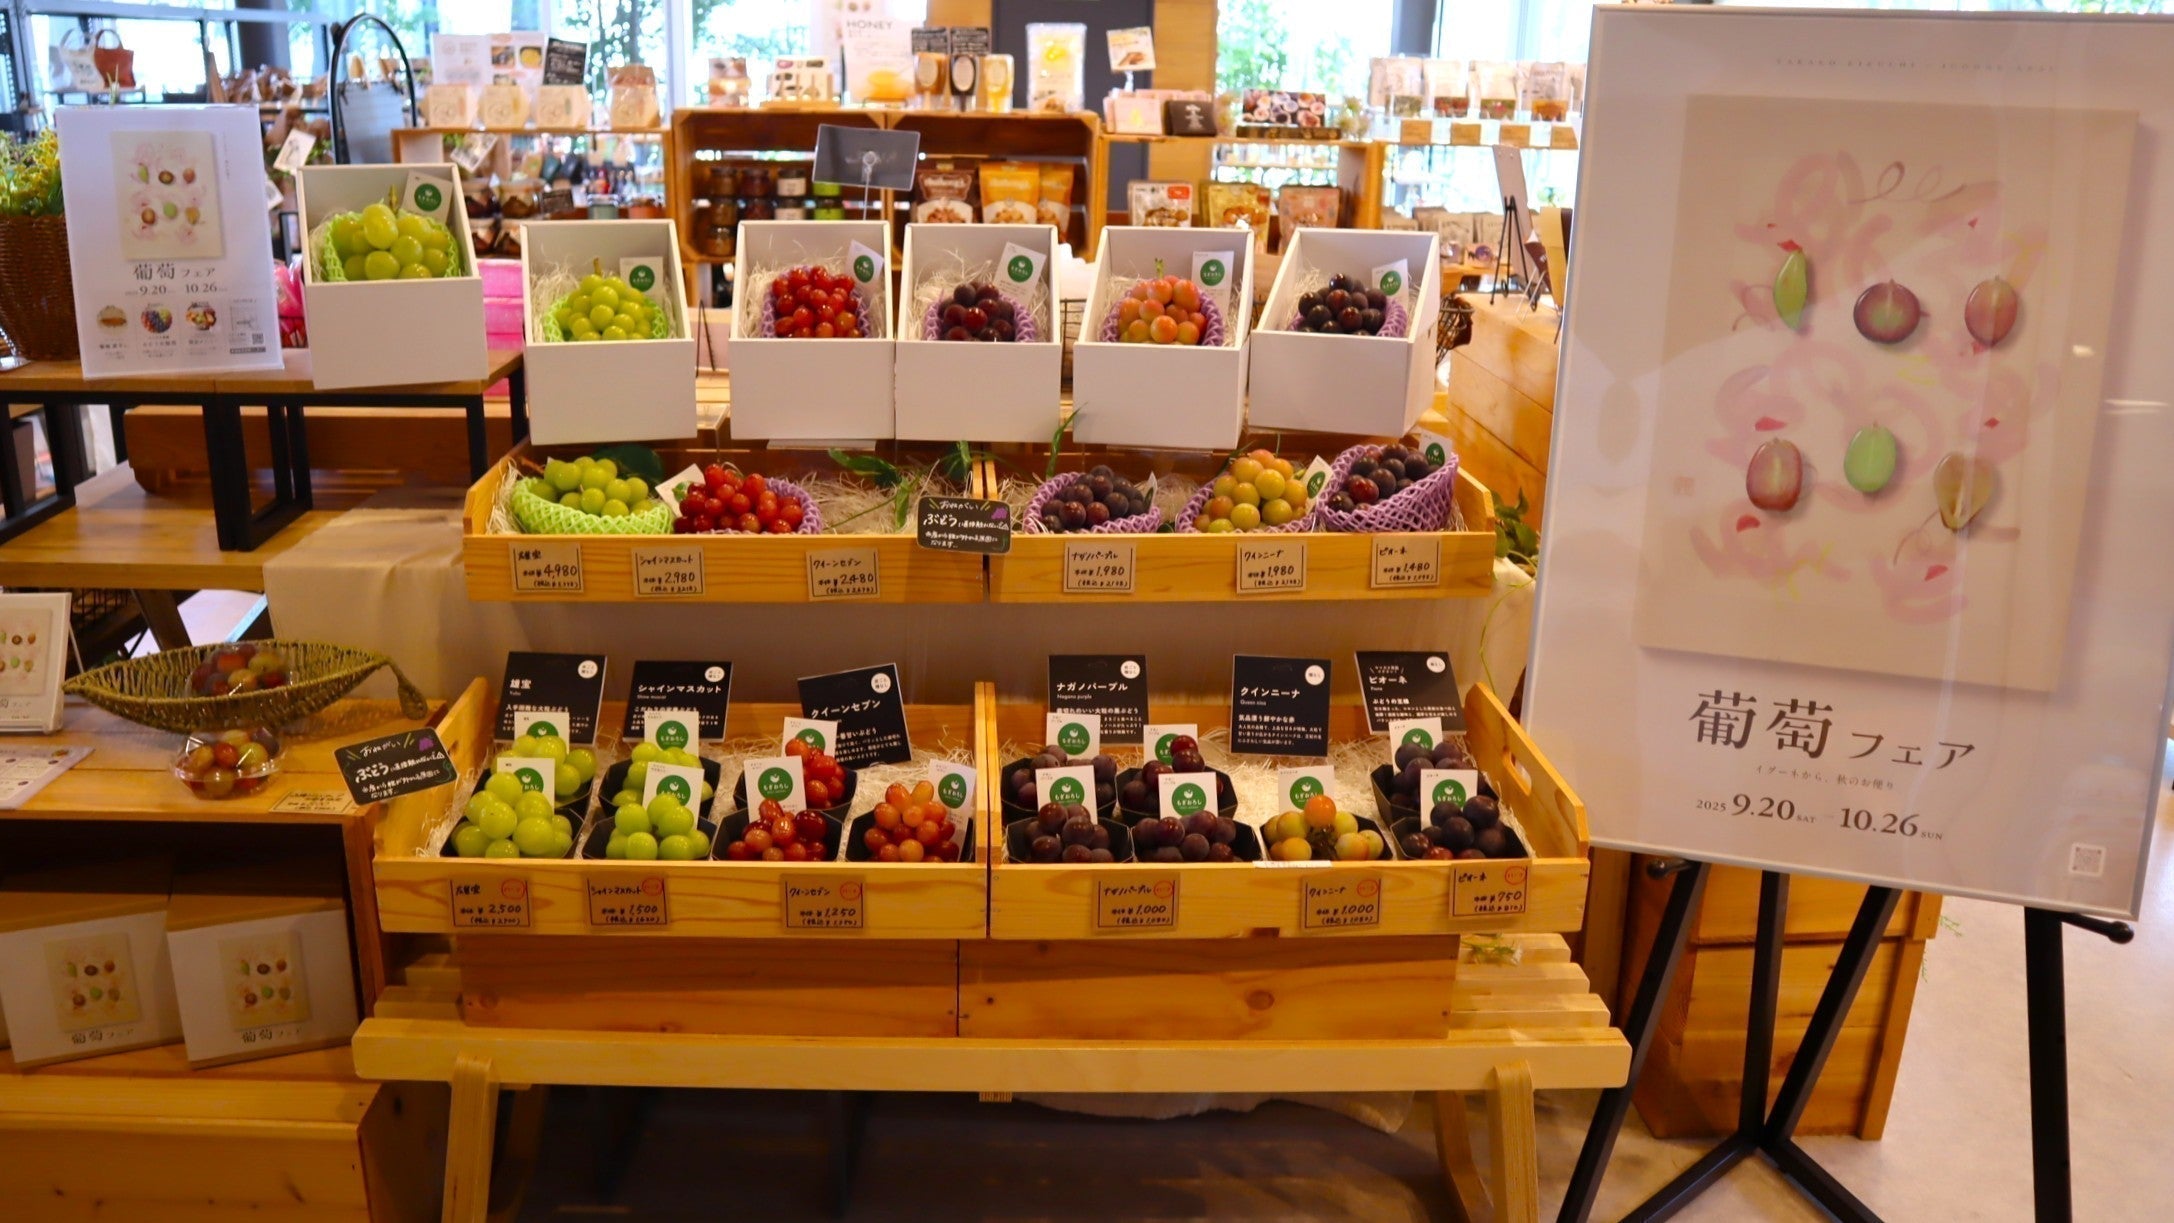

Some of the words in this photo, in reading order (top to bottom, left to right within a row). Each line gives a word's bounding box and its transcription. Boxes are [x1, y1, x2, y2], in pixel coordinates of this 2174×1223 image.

[133, 263, 216, 280] 葡萄フェア
[510, 678, 532, 689] 雄宝
[1369, 676, 1407, 684] ピオーネ
[638, 684, 722, 694] シャインマスカット
[1056, 682, 1128, 691] ナガノパープル
[1241, 686, 1300, 698] クインニーナ
[812, 700, 880, 720] クイーンセブン
[1688, 690, 1976, 769] 葡萄フェア
[1696, 799, 1727, 812] 2025
[1731, 793, 1796, 821] 9.20
[1796, 814, 1816, 824] SAT
[1840, 807, 1920, 838] 10.26
[1920, 830, 1944, 840] SUN
